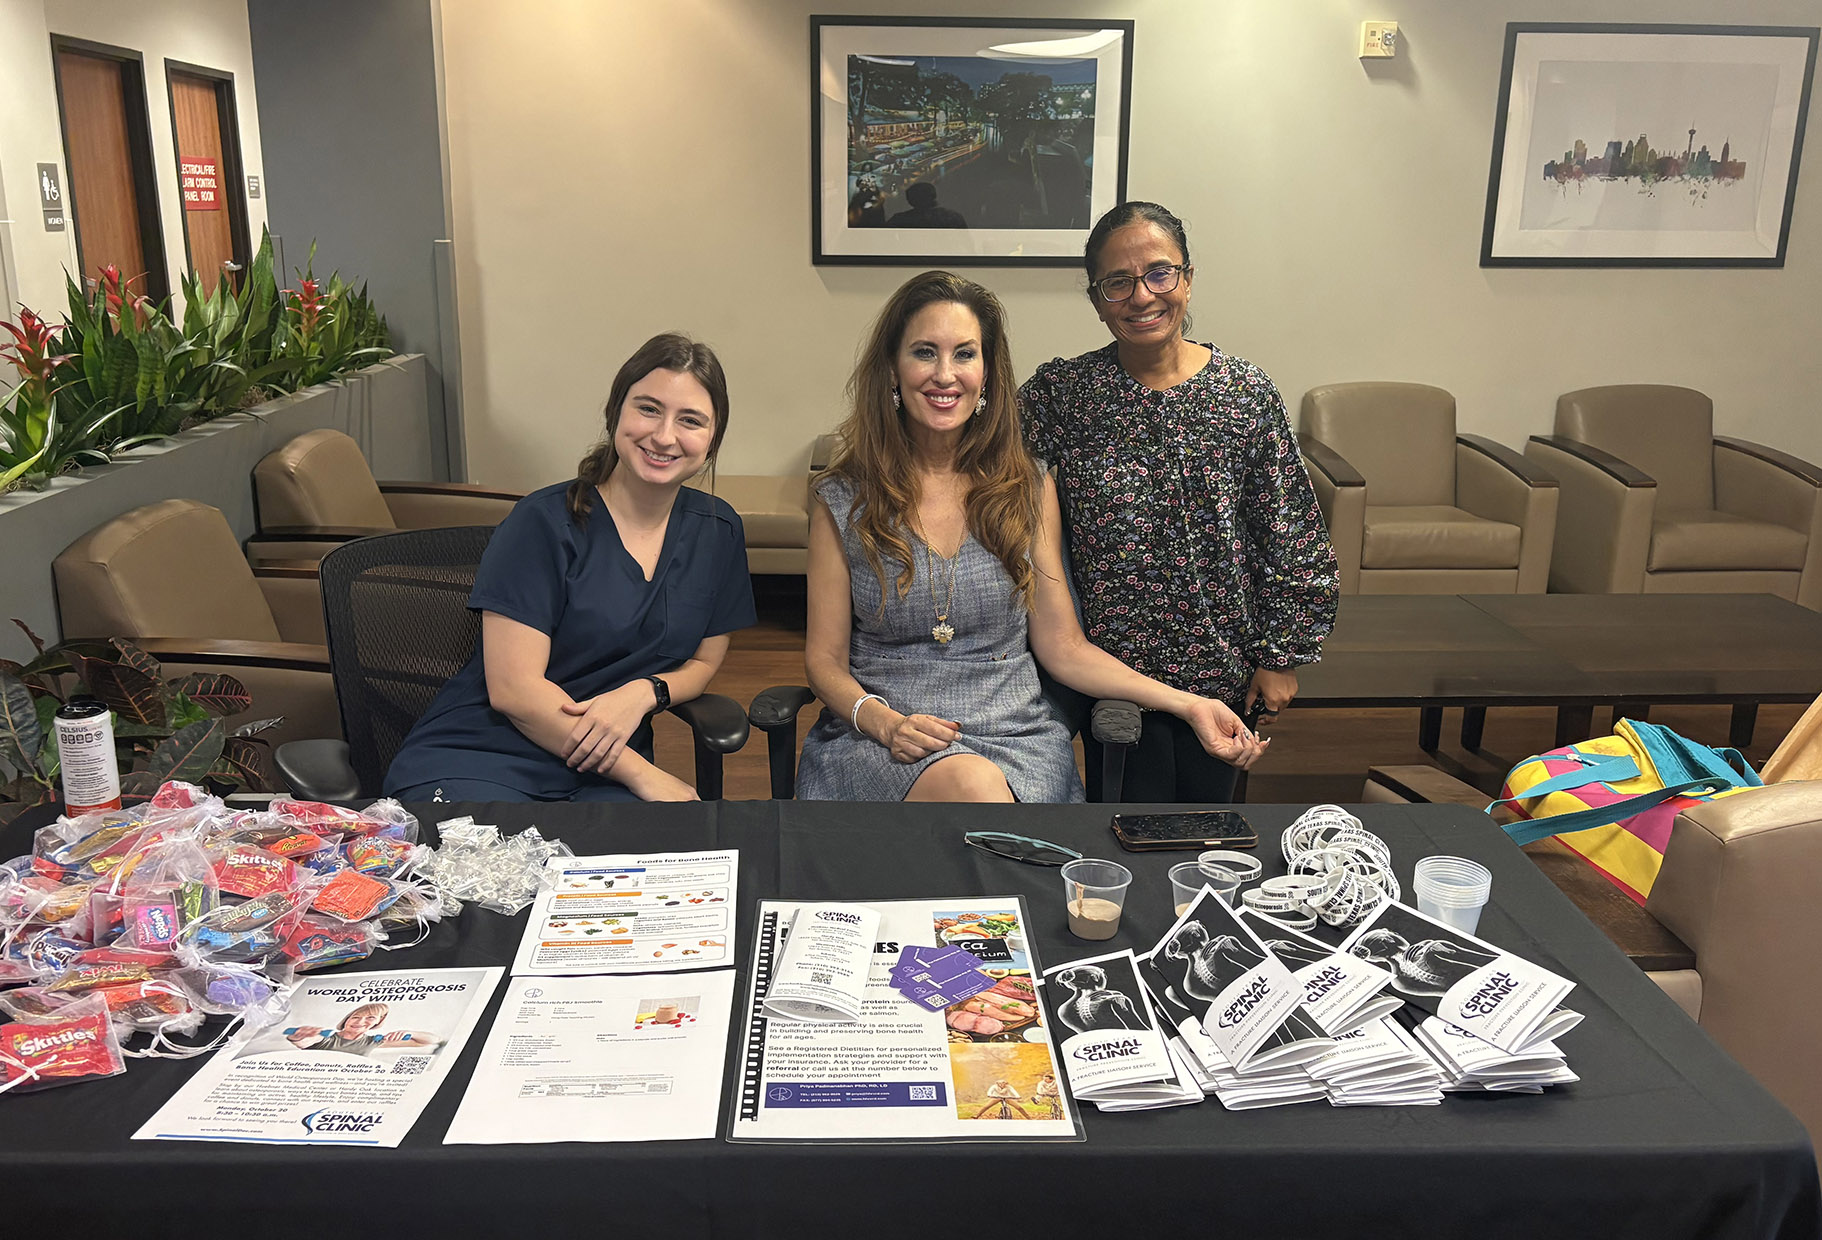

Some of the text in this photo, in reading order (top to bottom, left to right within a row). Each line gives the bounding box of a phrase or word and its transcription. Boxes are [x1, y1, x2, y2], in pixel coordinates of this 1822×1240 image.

[196, 178, 217, 188] CONTROL
[184, 191, 214, 202] PANEL ROOM
[1355, 829, 1374, 840] SPINAL
[1344, 836, 1363, 845] SPINAL
[822, 911, 862, 921] SPINAL
[1348, 904, 1361, 921] TEXAS
[824, 916, 860, 926] CLINIC
[961, 941, 988, 950] Ca
[359, 978, 424, 988] CELEBRATE
[1306, 971, 1348, 1002] CLINIC
[362, 984, 467, 995] OSTEOPOROSIS
[1465, 971, 1510, 1012] SPINAL
[1224, 975, 1268, 1020] SPINAL
[1315, 974, 1372, 1020] FRACTURE LIAISON SERVICE
[1479, 978, 1520, 1015] CLINIC
[1232, 984, 1270, 1024] CLINIC
[1494, 1014, 1516, 1038] FRACTURE
[1513, 997, 1532, 1017] LIAISON
[1529, 982, 1547, 1000] SERVICE
[1234, 1026, 1254, 1050] FRACTURE
[1254, 1009, 1273, 1028] LIAISON
[1272, 990, 1290, 1009] SERVICE
[19, 1029, 97, 1056] Skittles
[1083, 1038, 1142, 1054] SPINAL
[1364, 1042, 1388, 1050] SERVICE
[1088, 1046, 1140, 1062] CLINIC
[1462, 1046, 1490, 1055] FRACTURE
[1078, 1070, 1106, 1080] FRACTURE
[317, 1114, 384, 1124] SPINAL
[316, 1123, 374, 1133] CLINIC
